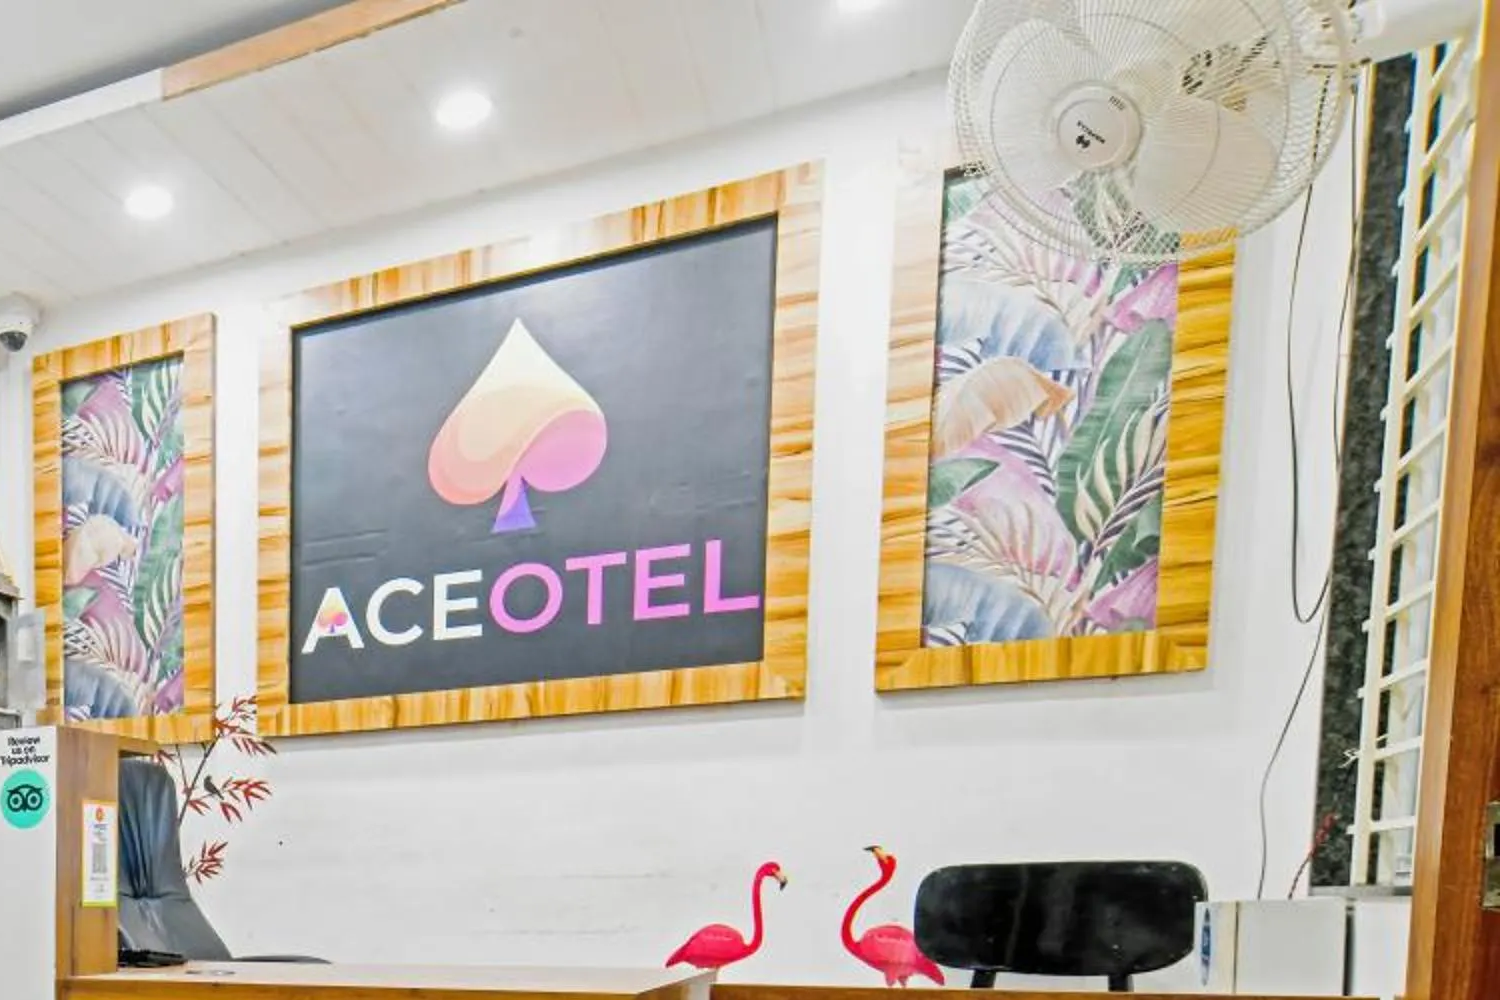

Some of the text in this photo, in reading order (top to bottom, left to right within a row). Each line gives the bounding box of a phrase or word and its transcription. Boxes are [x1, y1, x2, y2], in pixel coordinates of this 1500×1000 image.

[301, 539, 760, 655] ACEOTEL
[7, 735, 41, 746] Review
[0, 754, 50, 767] Tripadvisor
